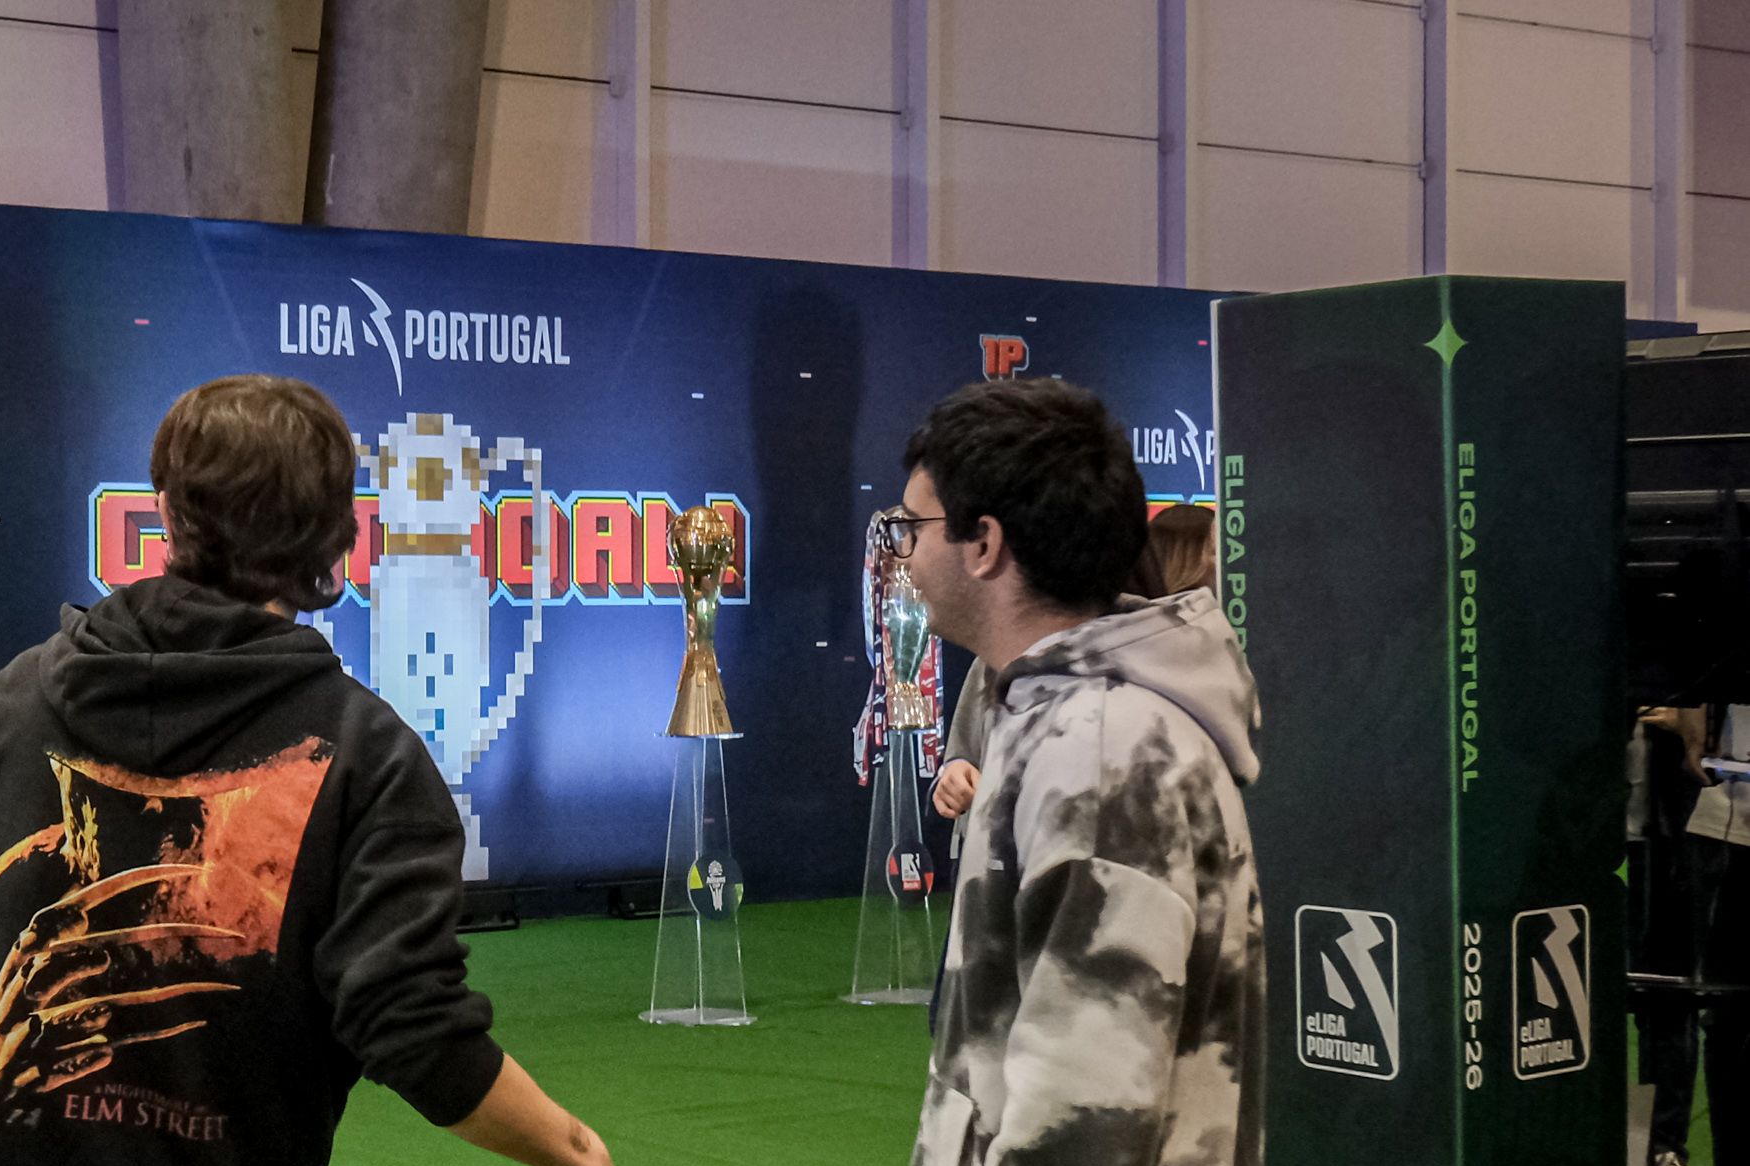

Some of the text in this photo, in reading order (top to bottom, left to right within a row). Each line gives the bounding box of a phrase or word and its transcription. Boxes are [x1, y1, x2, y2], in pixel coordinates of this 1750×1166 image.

[279, 302, 570, 365] LIGA PORTUGAL
[981, 335, 1027, 378] 1P
[1133, 427, 1177, 464] LIGA
[1225, 455, 1246, 564] ELIGA
[1459, 443, 1479, 792] ELIGA PORTUGAL
[1306, 1012, 1347, 1037] eLIGA
[1464, 923, 1483, 1090] 2025-26
[1306, 1035, 1379, 1068] PORTUGAL
[1520, 1038, 1576, 1069] PORTUGAL
[63, 1094, 228, 1141] ELM STREET
